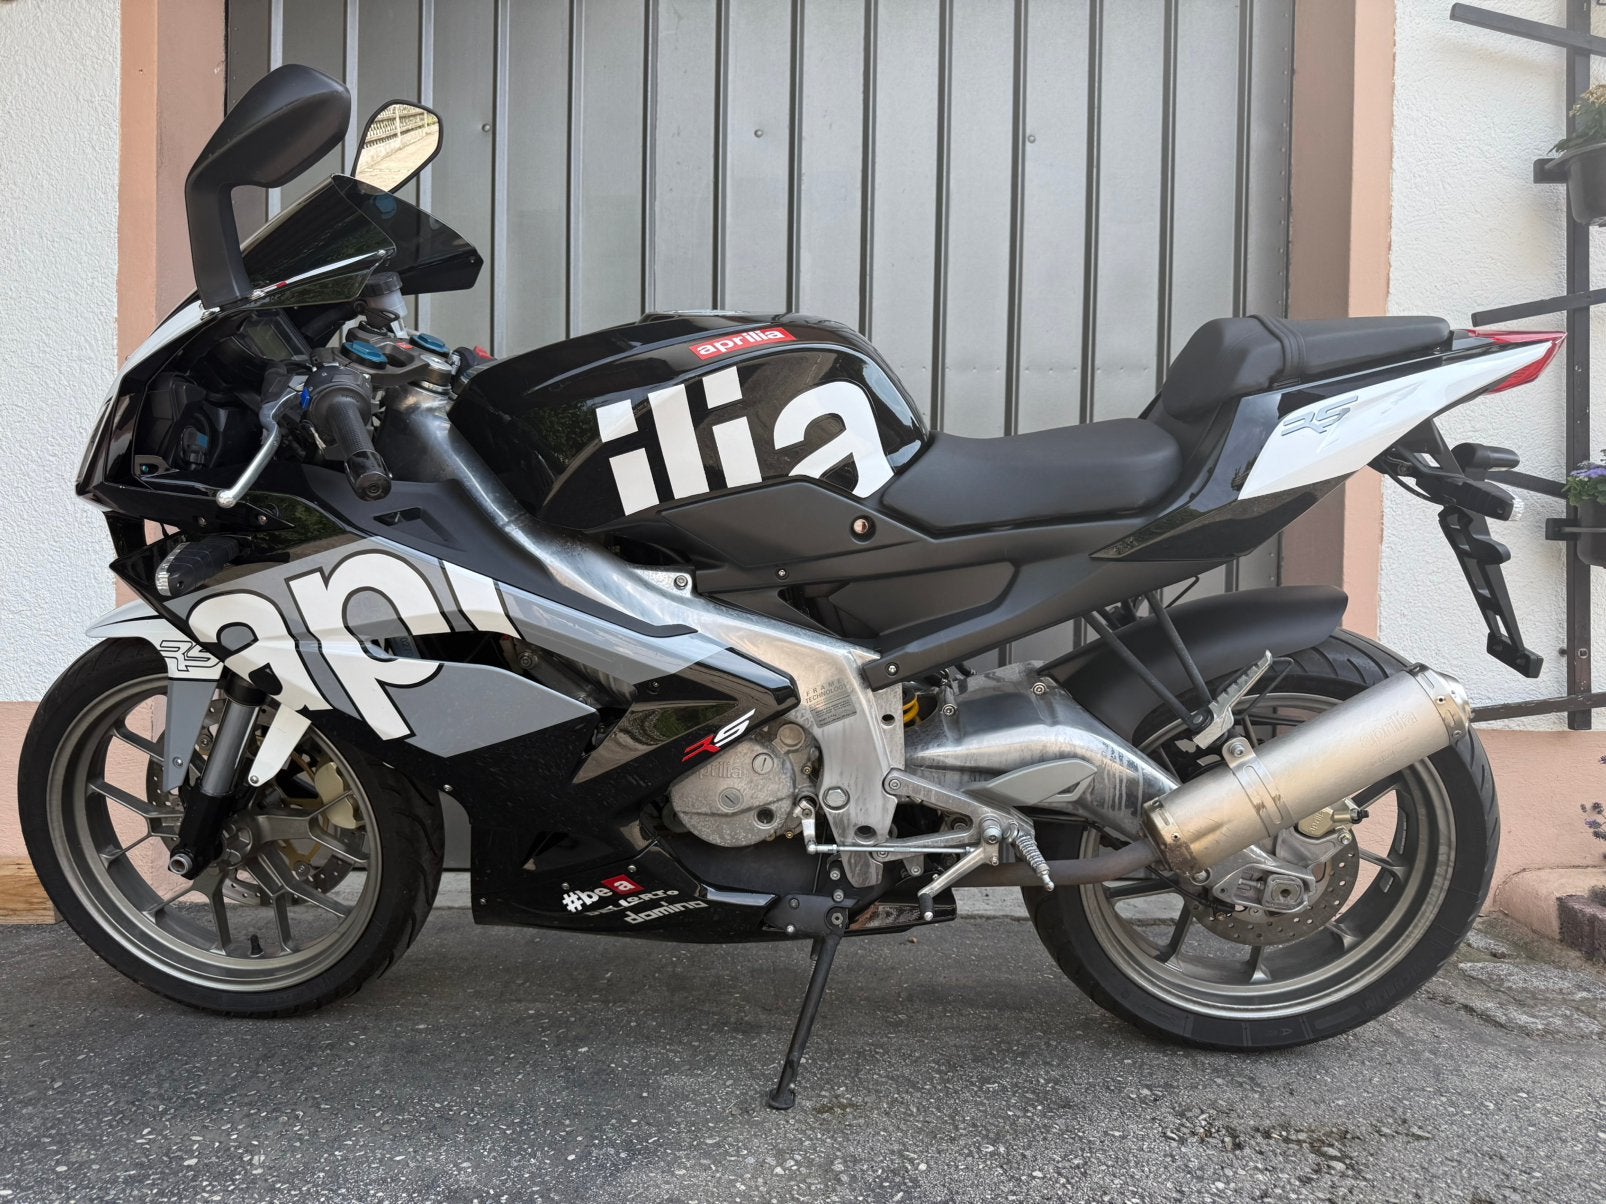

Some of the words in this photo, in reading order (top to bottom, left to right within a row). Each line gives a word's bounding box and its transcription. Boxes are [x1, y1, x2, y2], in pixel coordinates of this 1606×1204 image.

[697, 330, 785, 355] aprilia
[1281, 395, 1358, 437] RS
[596, 366, 895, 516] ilia
[805, 684, 848, 704] TECHNOLOGY
[681, 708, 756, 762] RS
[698, 761, 743, 780] prilia
[623, 900, 709, 924] domino
